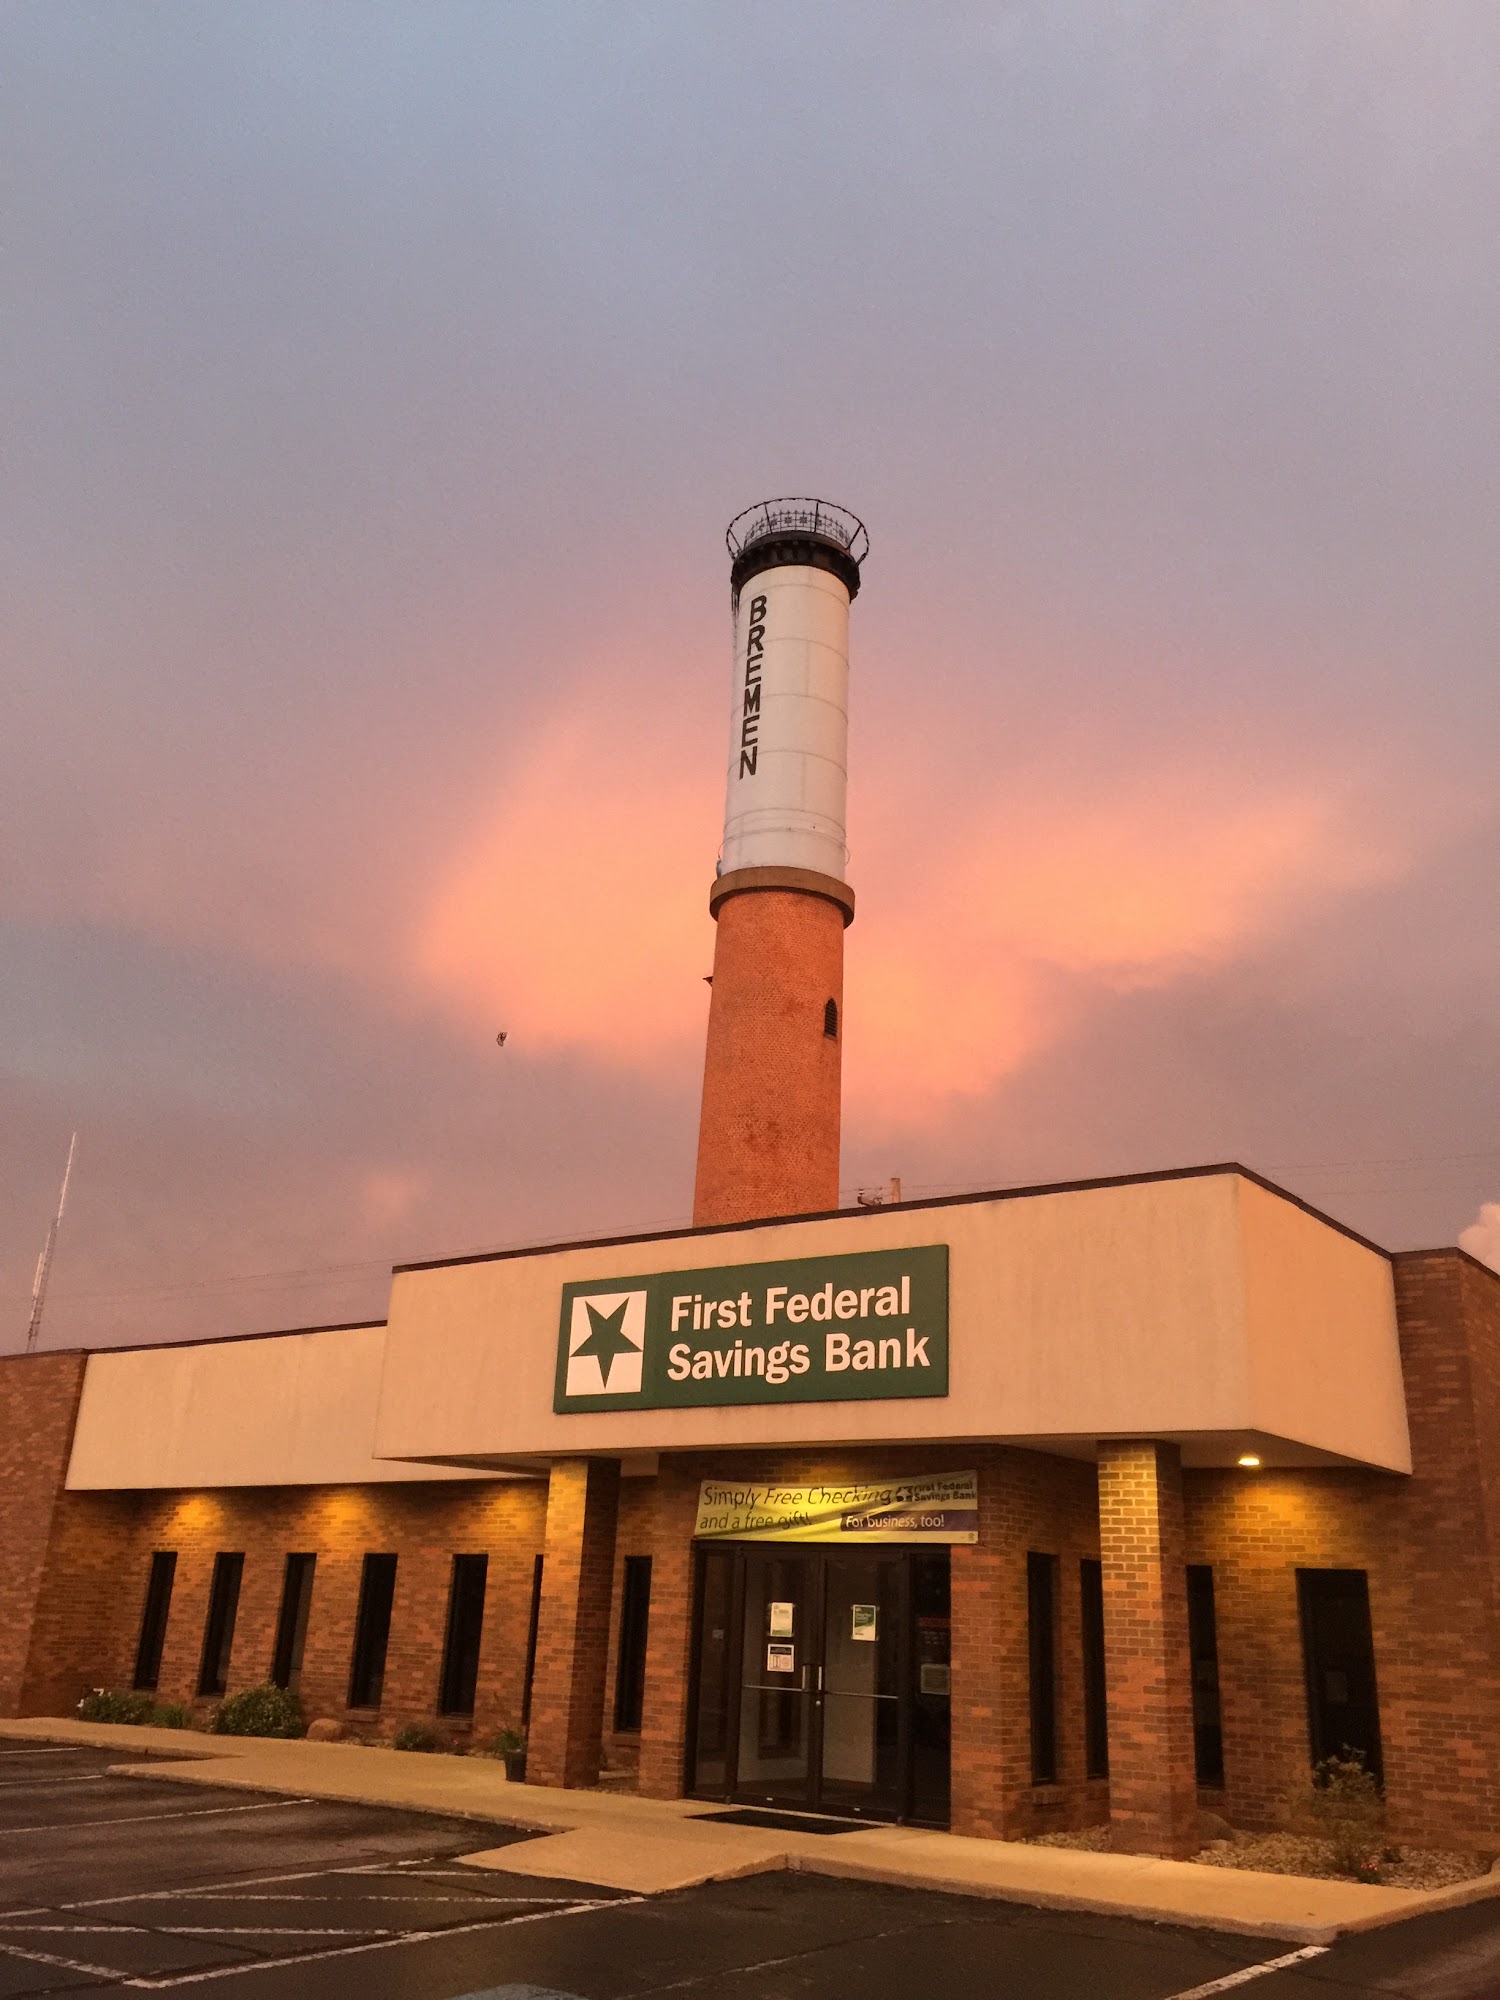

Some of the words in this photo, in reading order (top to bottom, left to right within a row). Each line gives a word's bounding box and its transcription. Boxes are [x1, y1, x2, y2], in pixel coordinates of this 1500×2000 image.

[739, 595, 767, 780] BREMEN
[670, 1291, 753, 1332] First
[765, 1275, 912, 1325] Federal
[667, 1339, 811, 1384] Savings
[824, 1327, 931, 1373] Bank
[914, 1491, 951, 1502] Savings
[953, 1489, 977, 1500] Bank
[937, 1480, 973, 1491] Federal
[703, 1486, 762, 1509] Simply
[763, 1487, 803, 1502] Free
[807, 1485, 892, 1505] Checking
[700, 1512, 729, 1529] and
[731, 1516, 742, 1529] a
[744, 1511, 774, 1529] free
[777, 1510, 812, 1530] gift!
[845, 1515, 864, 1528] For
[866, 1514, 918, 1529] business,
[920, 1513, 945, 1527] too!
